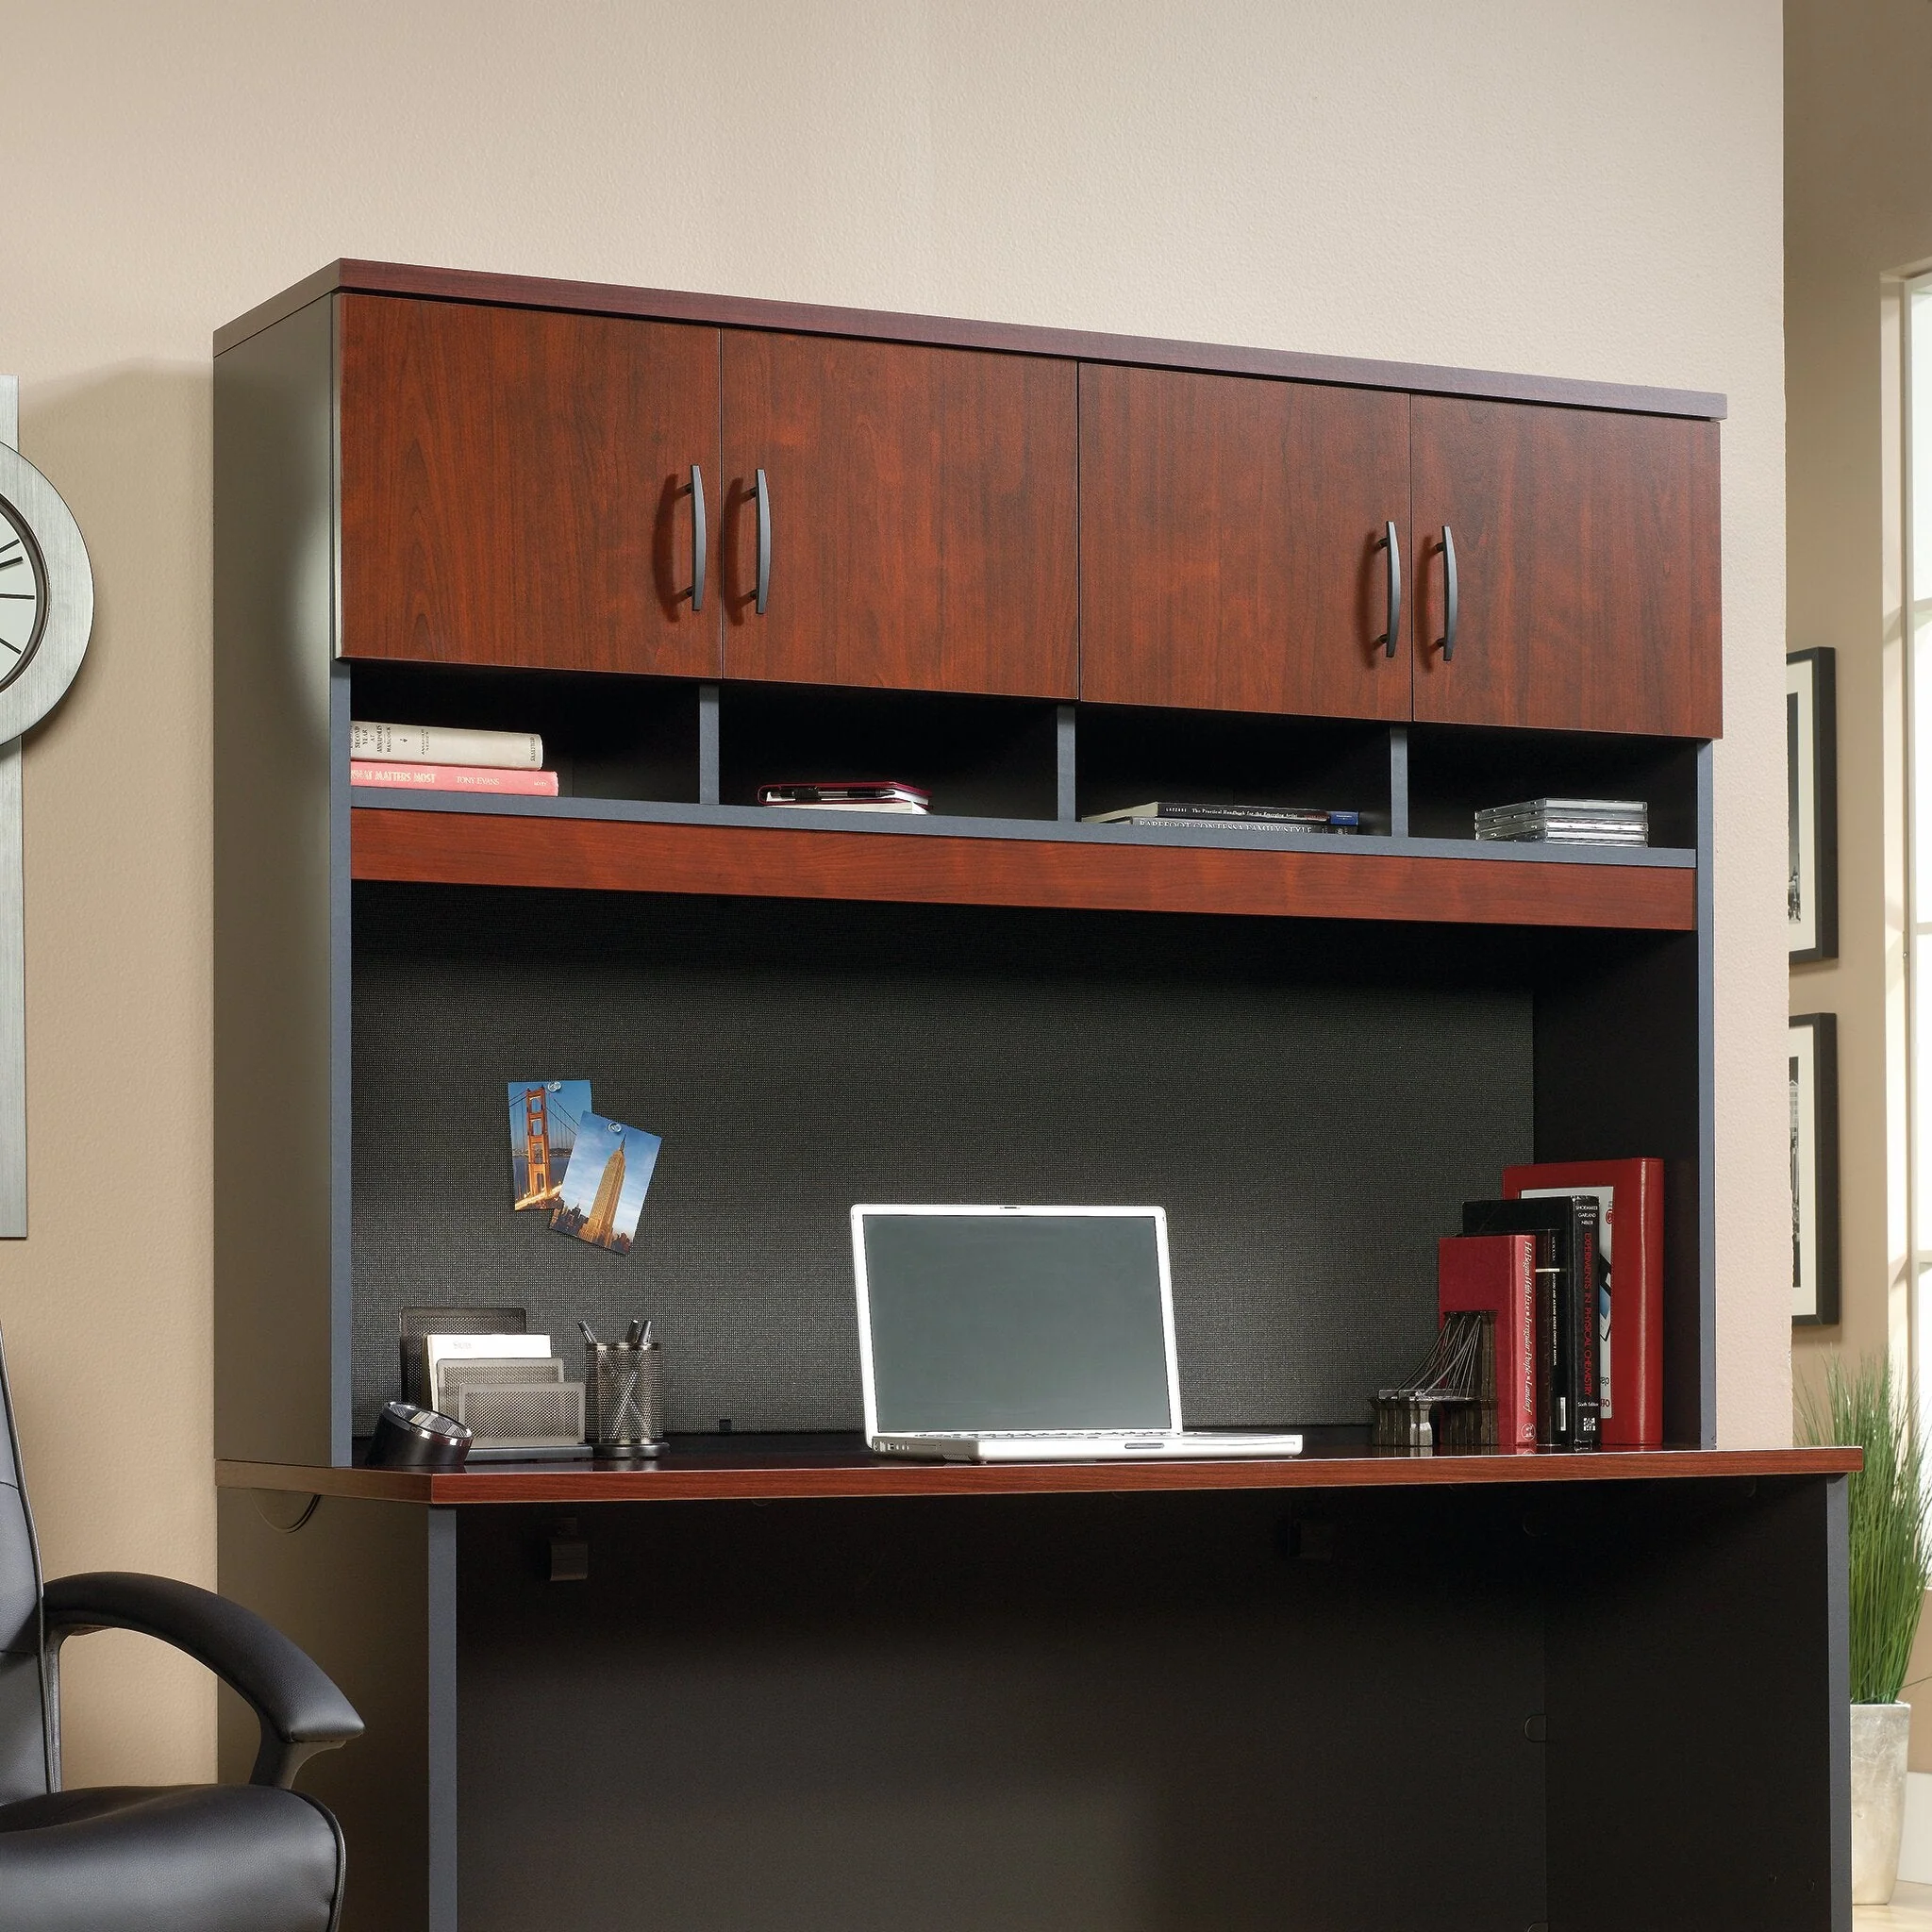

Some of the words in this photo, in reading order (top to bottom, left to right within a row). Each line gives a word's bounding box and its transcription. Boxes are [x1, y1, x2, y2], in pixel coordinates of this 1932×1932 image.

[375, 770, 411, 783] MATTERS
[413, 773, 436, 784] MOST
[456, 775, 475, 785] TONY
[476, 776, 500, 786] EVANS
[1524, 1241, 1533, 1254] He
[1522, 1253, 1532, 1276] Began
[1584, 1232, 1592, 1290] EXPERIMENTS
[1524, 1275, 1533, 1294] With
[1584, 1292, 1591, 1304] IN
[1523, 1317, 1533, 1352] Irregular
[1584, 1307, 1592, 1347] PHYSICAL
[1523, 1352, 1533, 1375] People
[1584, 1350, 1592, 1397] CHEMISTRY
[1523, 1380, 1533, 1415] Landorf
